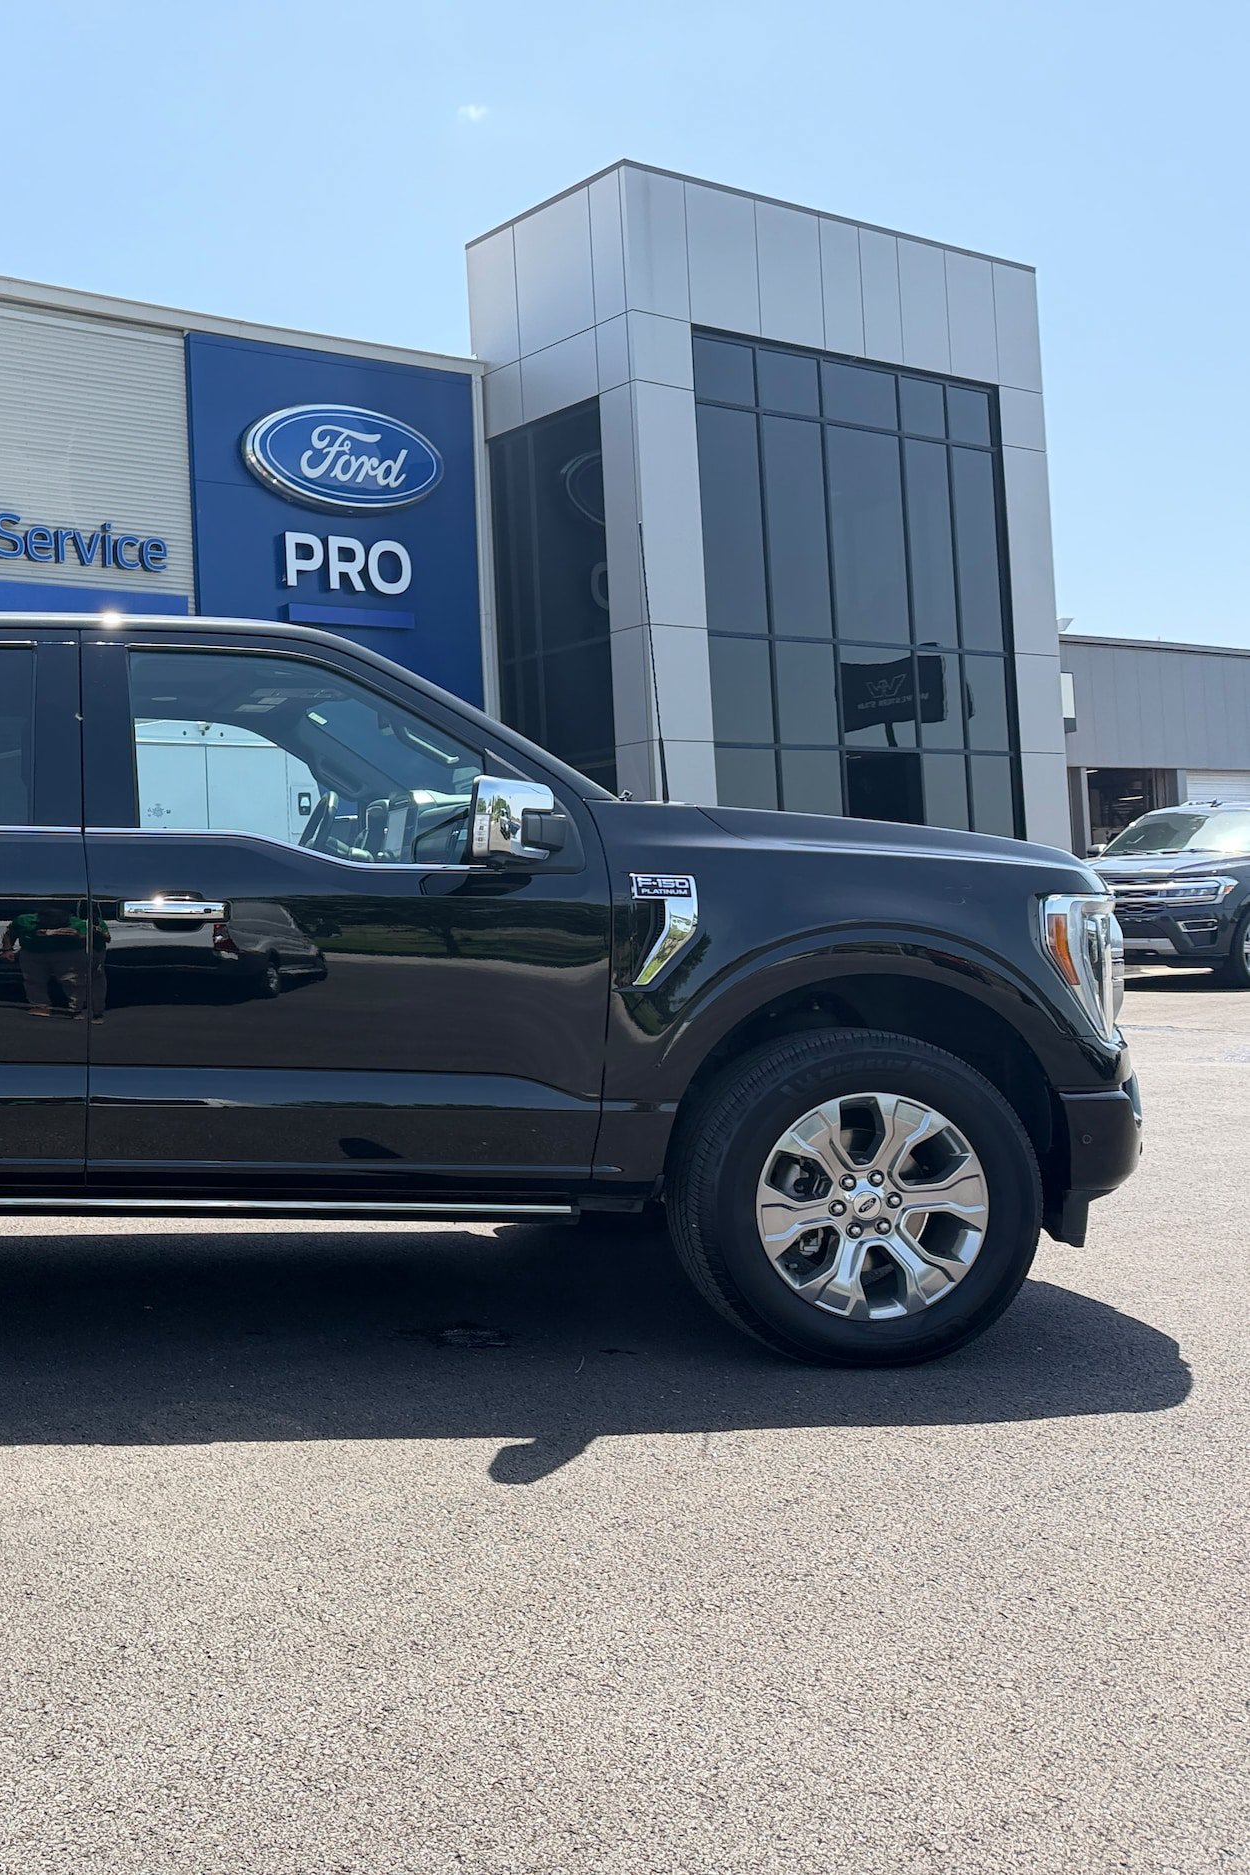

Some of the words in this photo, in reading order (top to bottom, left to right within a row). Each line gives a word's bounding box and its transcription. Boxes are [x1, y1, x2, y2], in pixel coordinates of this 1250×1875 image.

[299, 424, 409, 488] Ford
[285, 531, 412, 595] PRO
[637, 877, 689, 888] F-150
